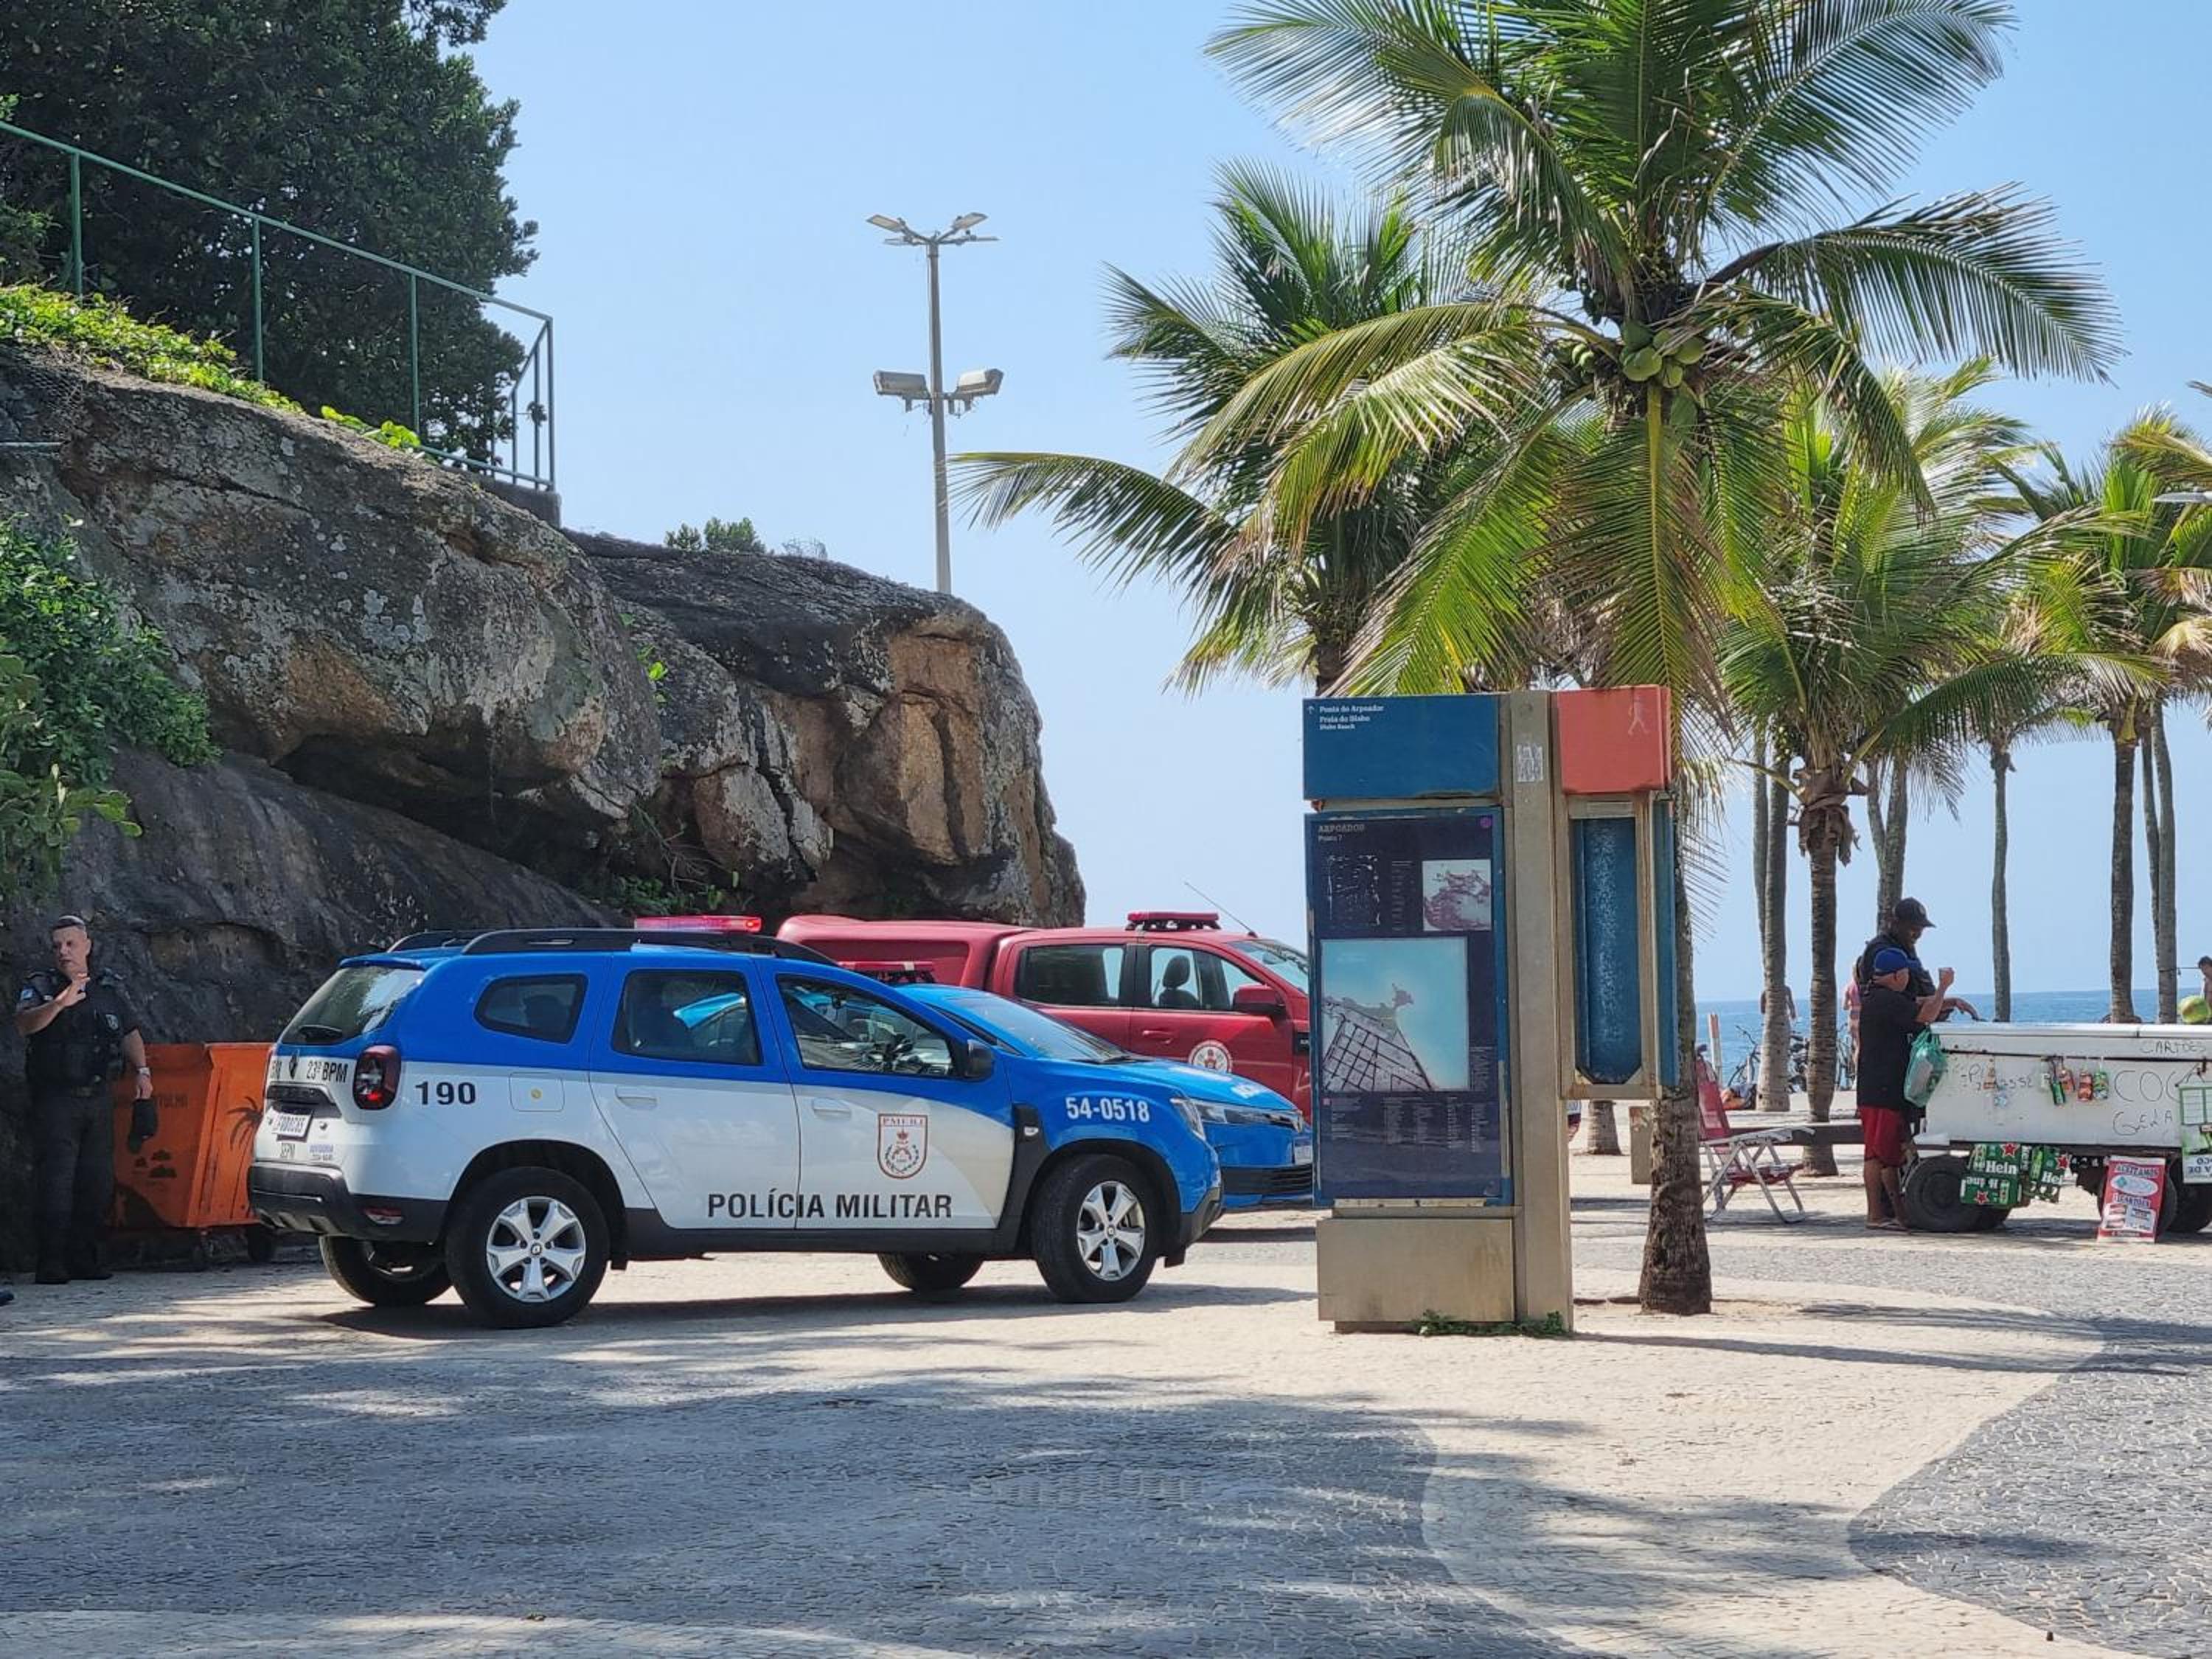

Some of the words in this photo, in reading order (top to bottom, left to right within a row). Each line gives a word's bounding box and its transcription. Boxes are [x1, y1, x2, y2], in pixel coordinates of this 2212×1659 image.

[321, 1061, 349, 1083] BPM
[414, 1081, 476, 1106] 190
[1065, 1097, 1150, 1123] 54-0518
[708, 1188, 826, 1218] POLÍCIA
[835, 1194, 953, 1219] MILITAR
